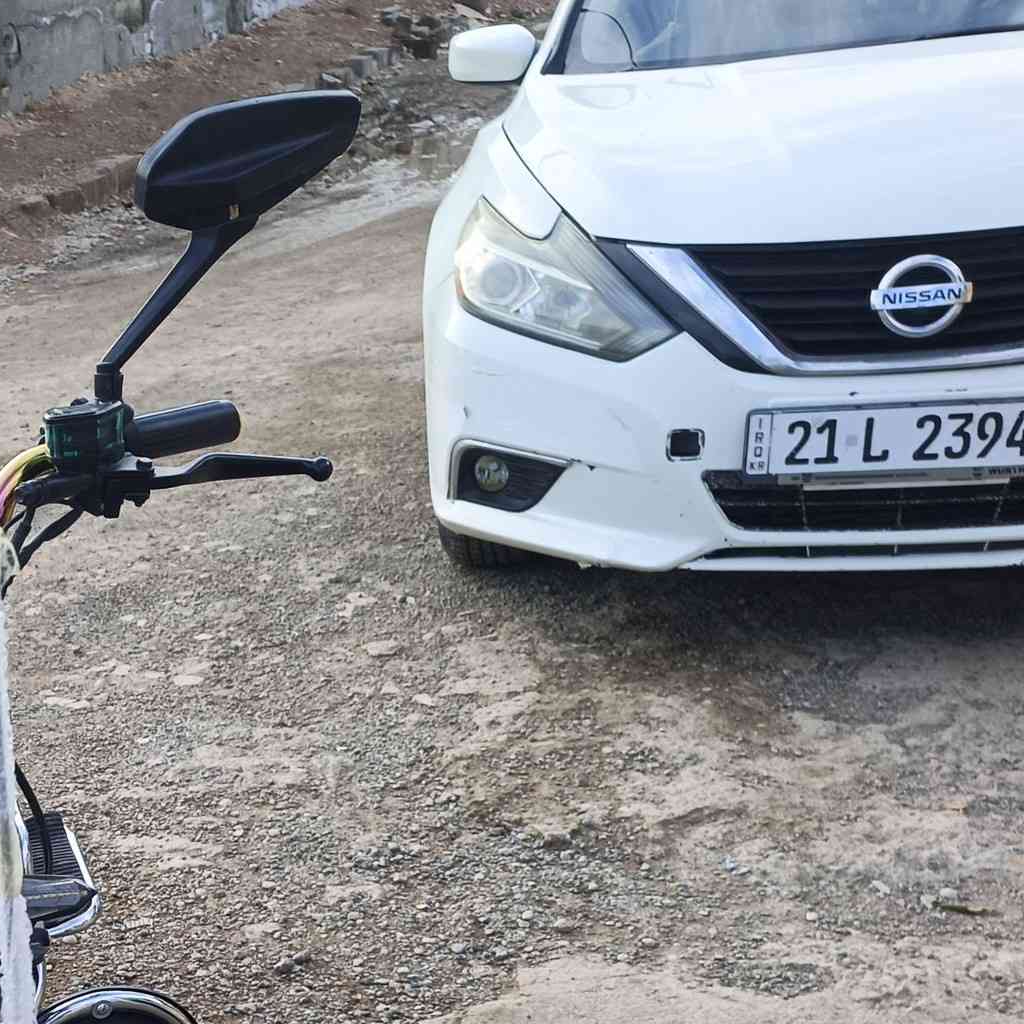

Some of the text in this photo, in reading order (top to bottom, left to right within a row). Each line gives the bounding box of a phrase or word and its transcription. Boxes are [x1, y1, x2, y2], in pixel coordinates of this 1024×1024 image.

[882, 287, 962, 305] NISSAN
[784, 410, 1024, 465] 21 L 2394
